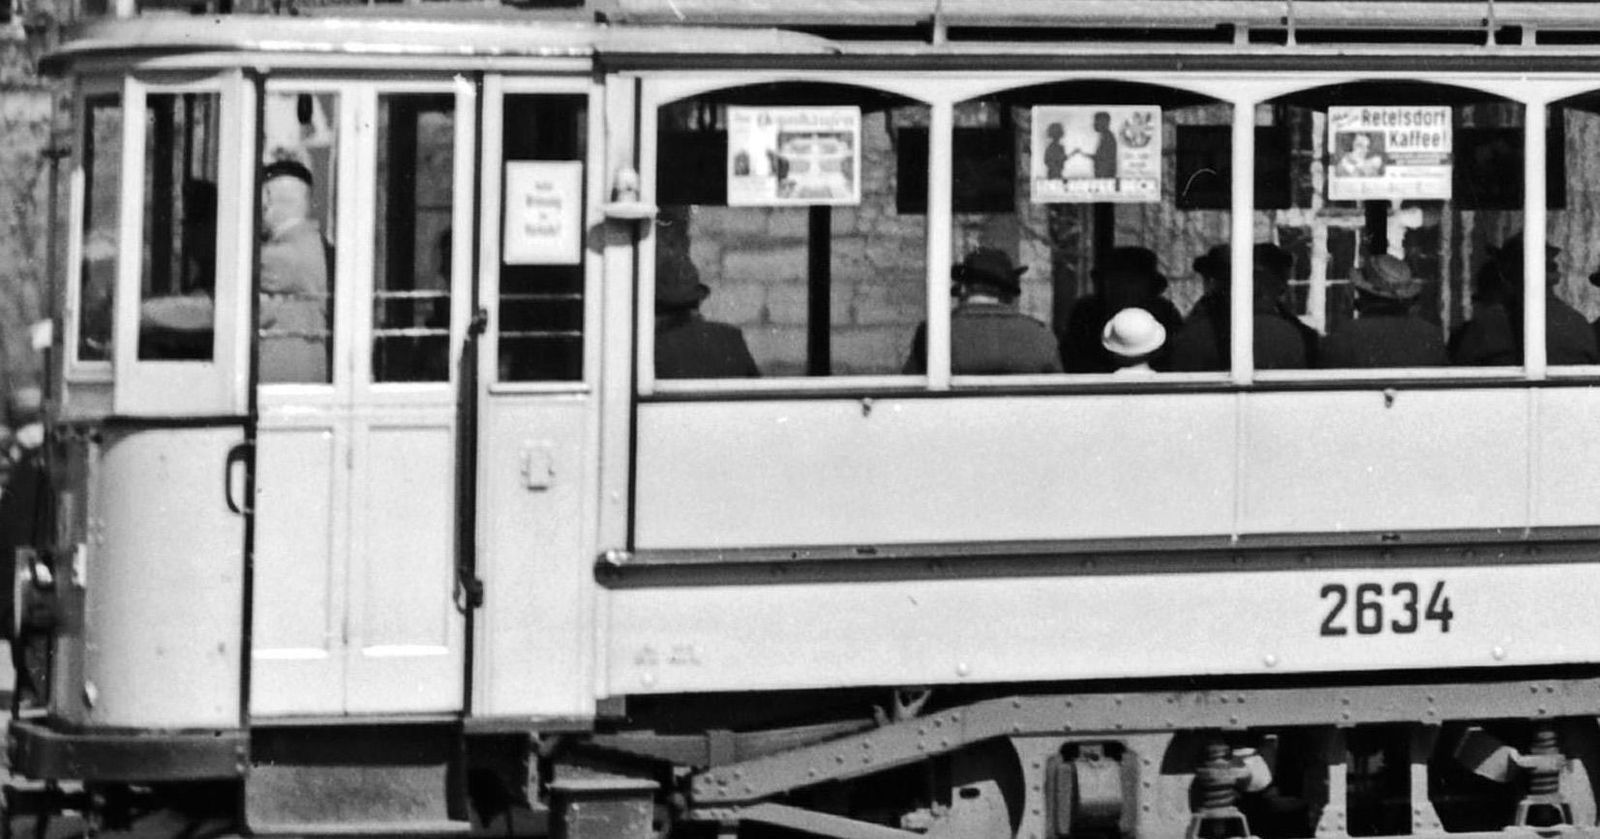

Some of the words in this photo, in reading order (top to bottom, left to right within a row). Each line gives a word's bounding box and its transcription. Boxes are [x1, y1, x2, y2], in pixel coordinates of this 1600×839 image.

[1361, 109, 1446, 126] Retelsdorf
[1388, 130, 1446, 146] Kaffee!
[1320, 581, 1454, 636] 2634
